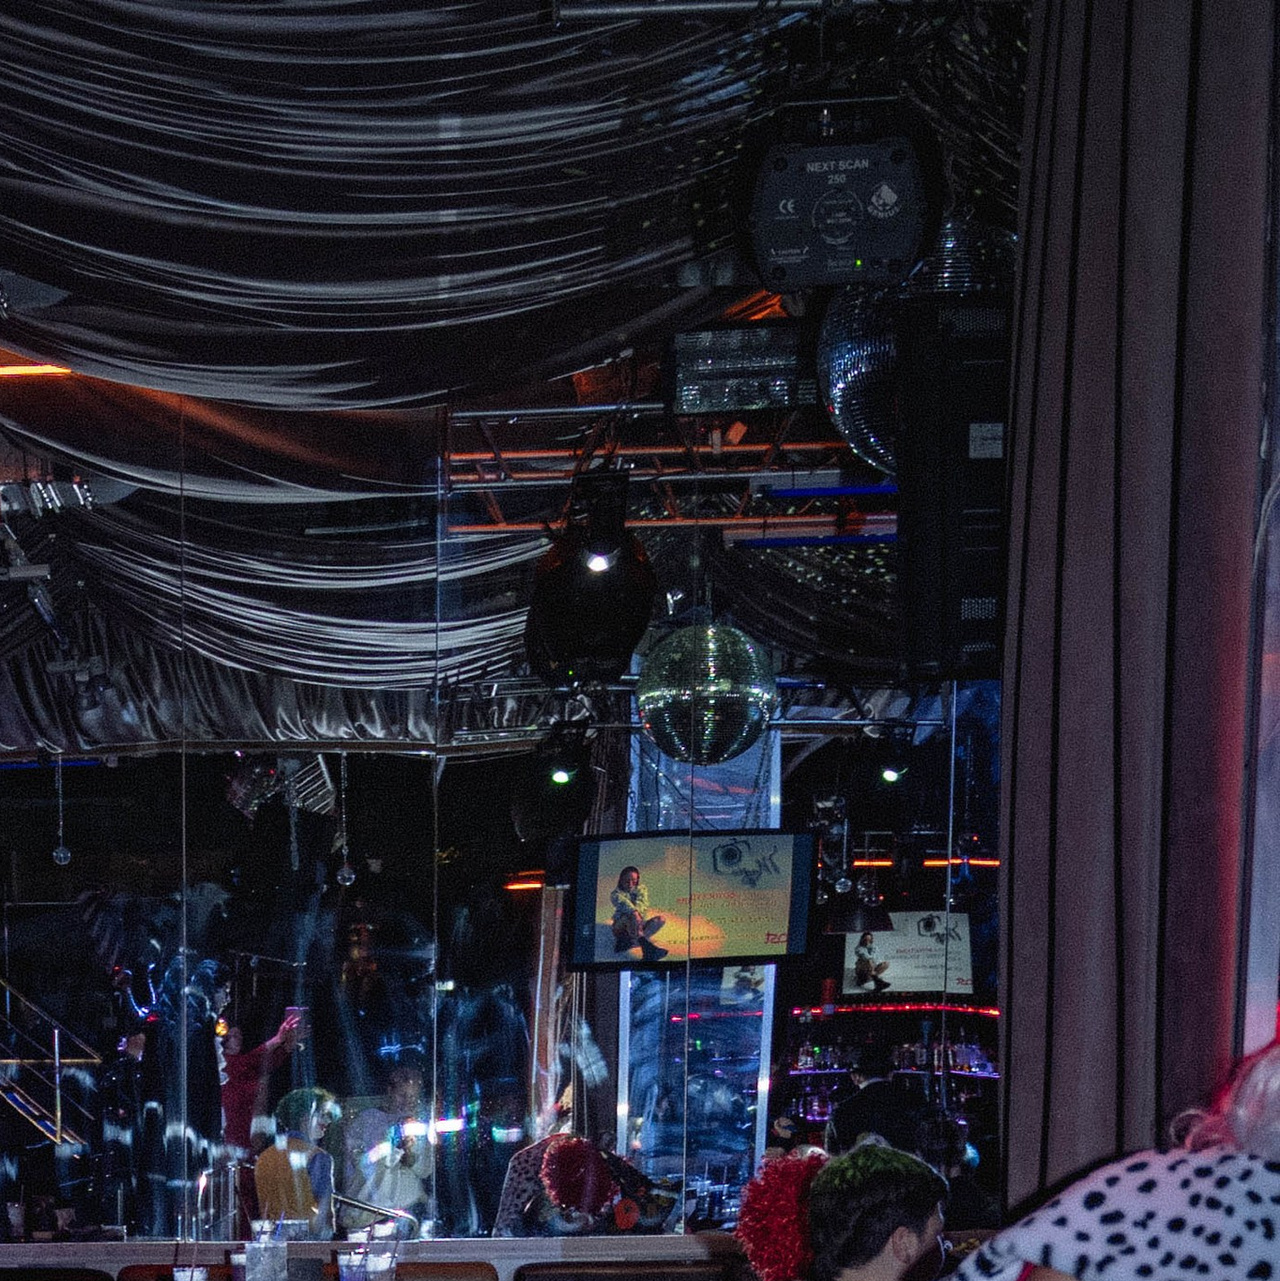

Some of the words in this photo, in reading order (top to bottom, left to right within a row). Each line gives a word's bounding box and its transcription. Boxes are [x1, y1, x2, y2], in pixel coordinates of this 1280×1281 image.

[807, 161, 835, 172] NEXT
[839, 159, 869, 171] SCAN
[828, 174, 847, 185] 250
